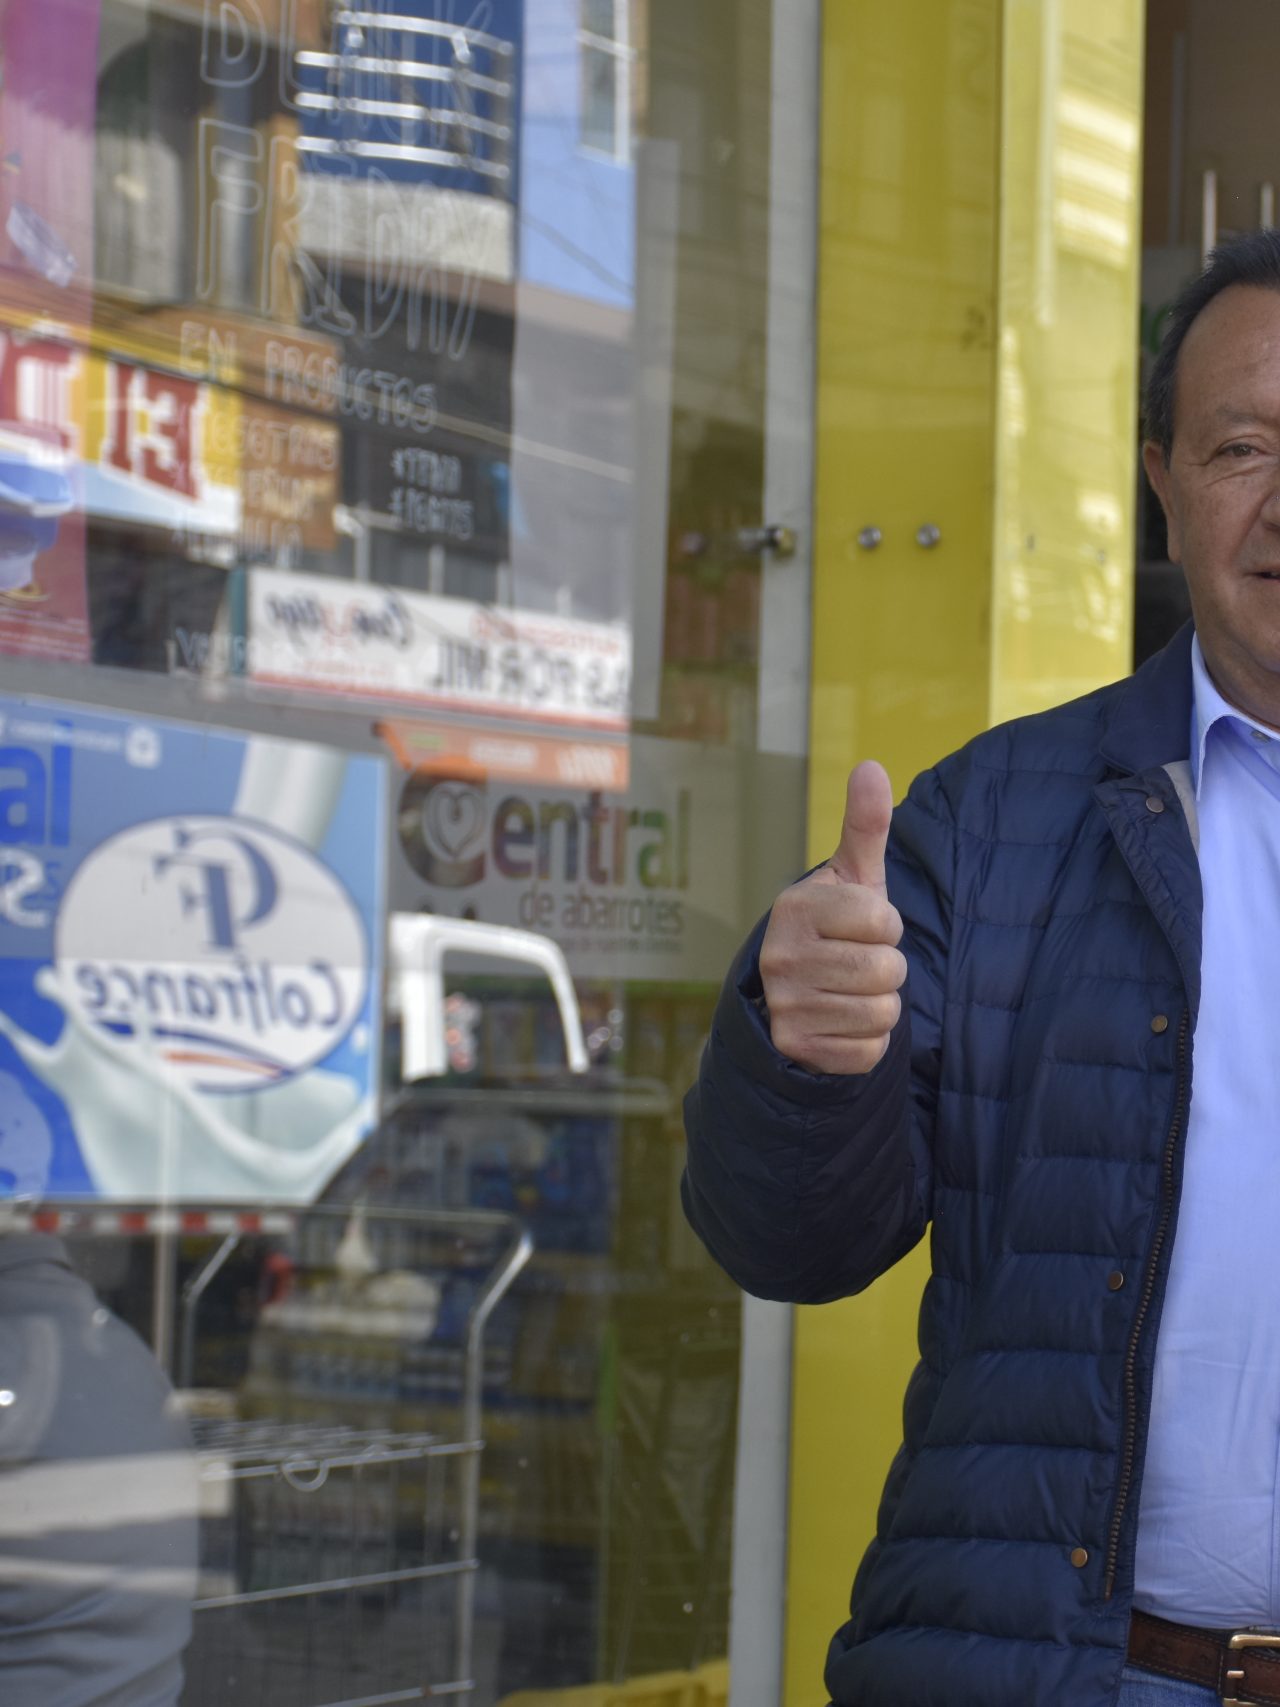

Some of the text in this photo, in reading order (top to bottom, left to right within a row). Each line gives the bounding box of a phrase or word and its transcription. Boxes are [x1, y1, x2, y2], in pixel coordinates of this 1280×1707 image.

[197, 117, 493, 362] FRIDAY
[265, 340, 438, 434] PRODUCTOS
[398, 772, 692, 891] Central
[519, 881, 686, 936] de abarrotes
